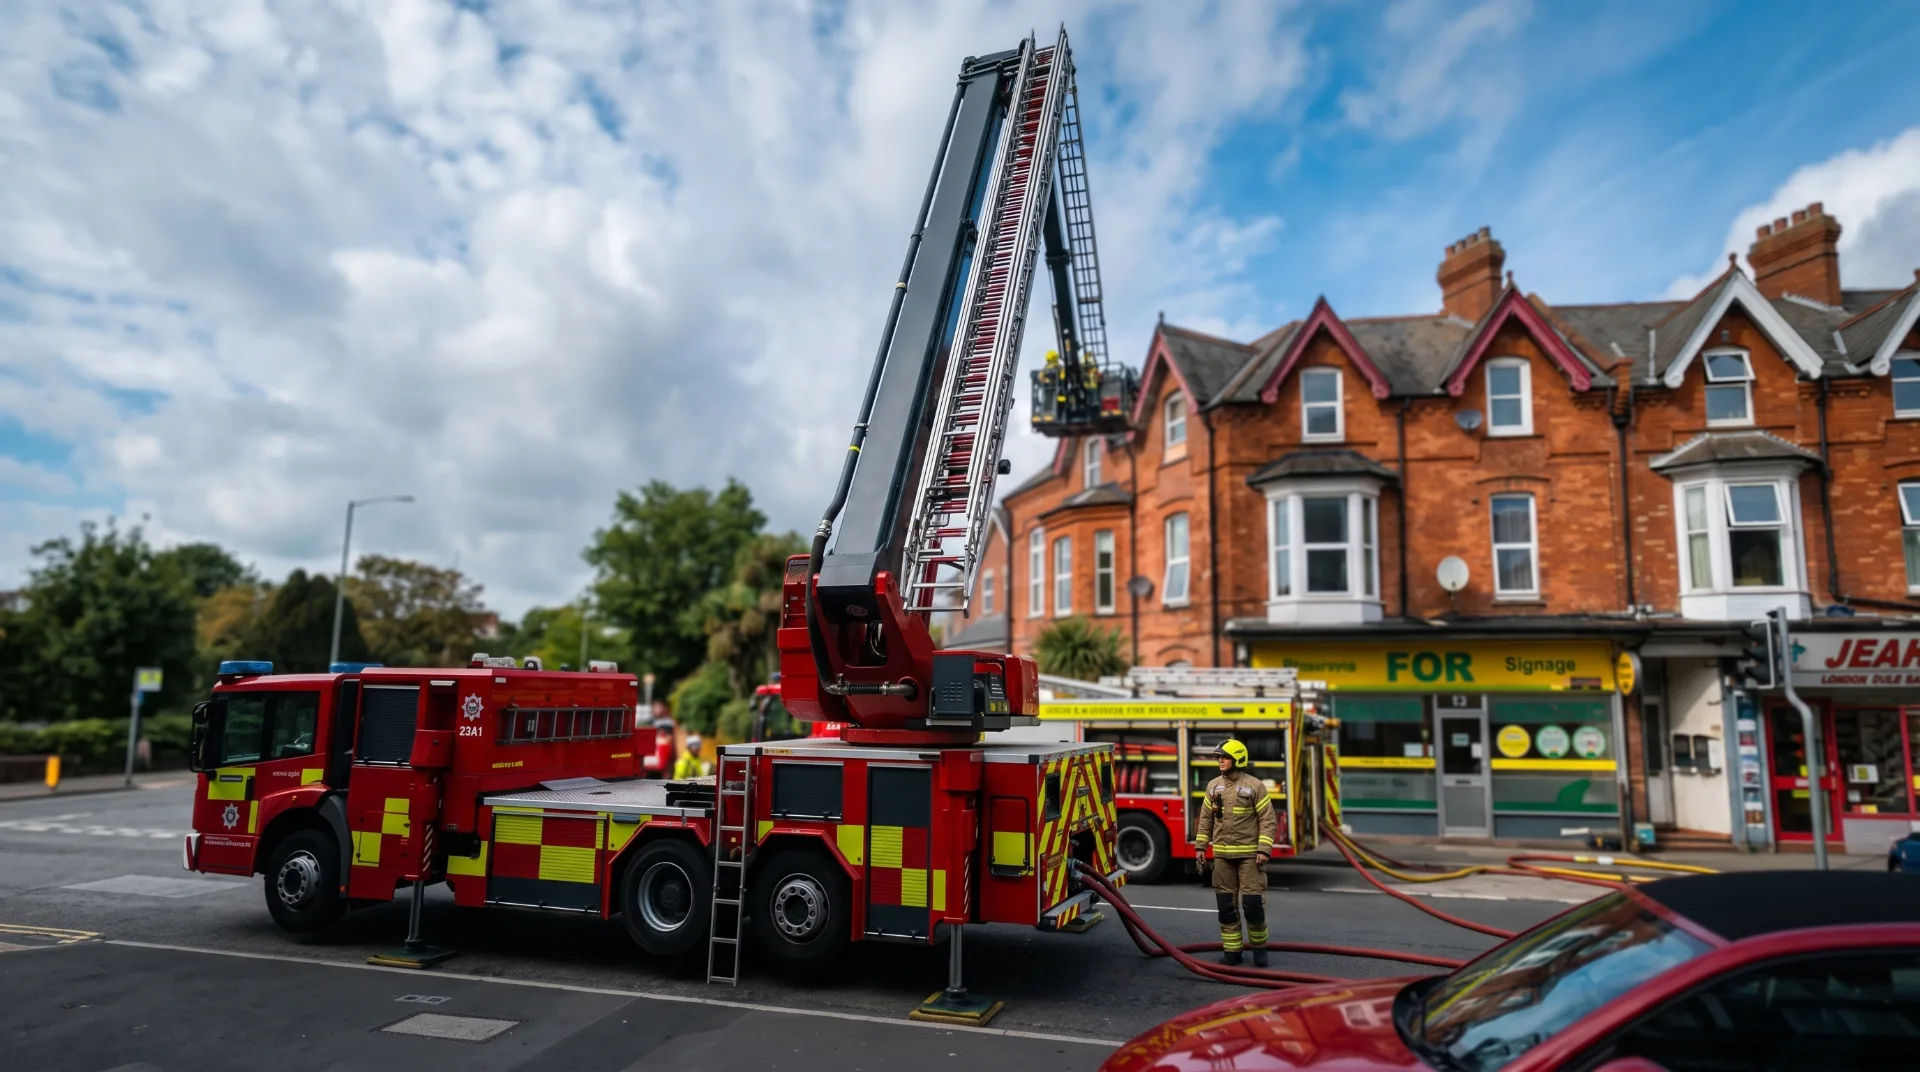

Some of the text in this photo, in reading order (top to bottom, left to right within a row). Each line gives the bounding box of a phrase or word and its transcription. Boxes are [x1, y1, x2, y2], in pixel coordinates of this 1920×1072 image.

[1386, 651, 1475, 683] FOR
[1505, 656, 1576, 675] Signage
[459, 726, 483, 737] 23A1
